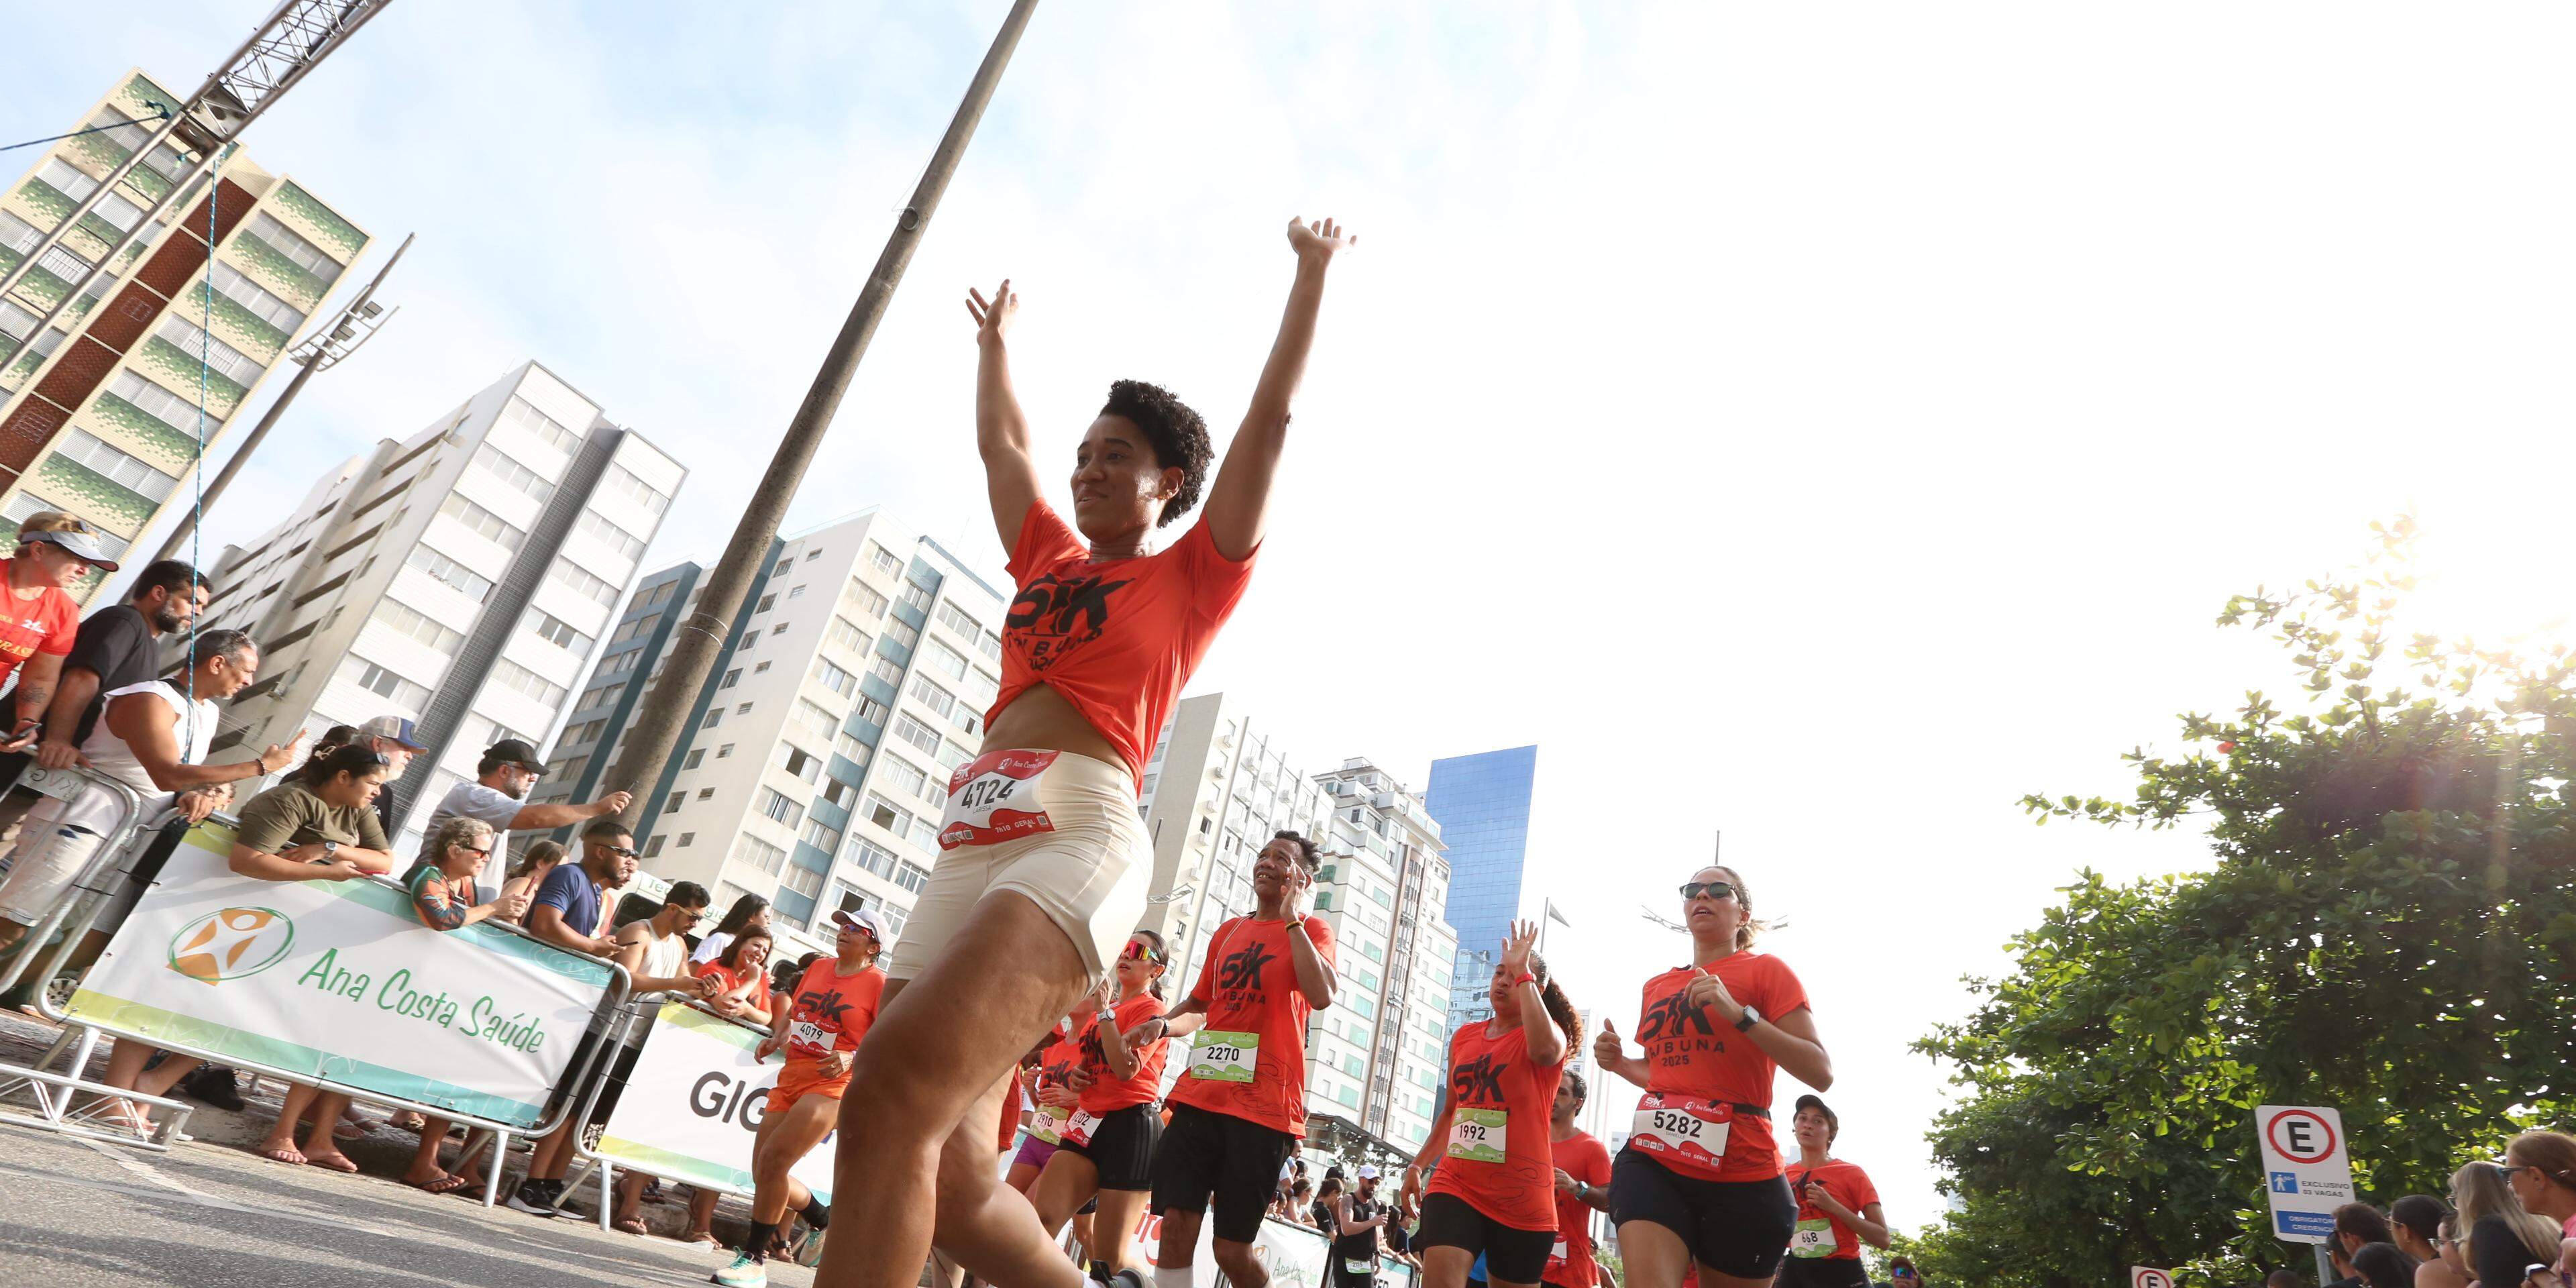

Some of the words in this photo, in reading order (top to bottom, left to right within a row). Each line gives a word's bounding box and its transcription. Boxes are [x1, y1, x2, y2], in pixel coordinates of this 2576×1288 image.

[961, 779, 1016, 809] 4724
[973, 805, 991, 814] LARISSA
[995, 824, 1012, 834] 7h10
[1014, 818, 1036, 828] GERAL
[1221, 941, 1277, 990] 5K
[297, 947, 370, 1003] Ana
[376, 968, 459, 1028] Costa
[459, 996, 545, 1054] Saúde
[800, 1024, 823, 1040] 4079
[1207, 1046, 1240, 1061] 2270
[1662, 1055, 1689, 1067] 2025
[1453, 1051, 1508, 1104] 5K
[1038, 1113, 1054, 1128] 2910
[1654, 1111, 1703, 1138] 5282
[1460, 1124, 1486, 1140] 1992
[1666, 1131, 1686, 1140] DANIELLE
[2286, 1121, 2315, 1153] E
[2302, 1181, 2350, 1190] EXCLUSIVO
